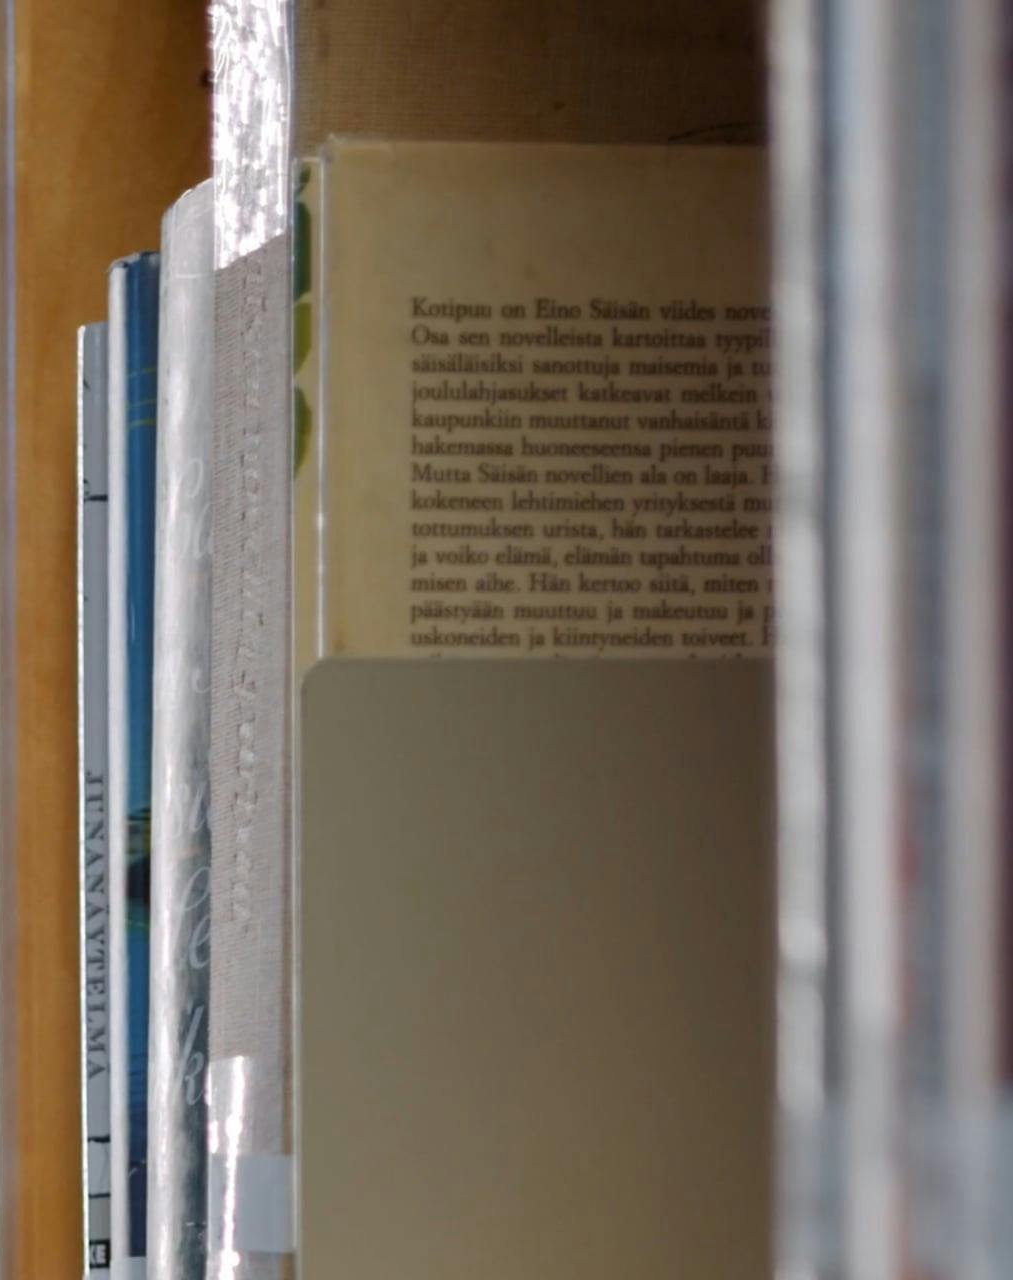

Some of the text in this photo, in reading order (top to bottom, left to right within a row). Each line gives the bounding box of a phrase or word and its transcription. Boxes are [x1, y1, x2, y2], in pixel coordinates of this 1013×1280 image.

[412, 297, 492, 324] Kotipuu
[501, 304, 526, 319] on
[535, 298, 582, 319] Eino
[590, 298, 651, 320] Säisän
[660, 299, 716, 320] viides
[411, 324, 450, 346] Osa
[459, 330, 491, 346] sen
[533, 353, 621, 380] sanottuja
[629, 354, 719, 375] maisemia
[726, 354, 746, 381] ja
[578, 381, 672, 403] katkeavat
[680, 382, 758, 403] melkein
[411, 407, 523, 434] kaupunkiin
[529, 411, 631, 430] muuttanut
[411, 434, 514, 456] hakemassa
[521, 435, 654, 457] huoneeseensa
[659, 436, 724, 463] pienen
[412, 462, 472, 484] Mutta
[479, 463, 539, 484] Säisän
[545, 463, 634, 485] novellien
[639, 464, 668, 485] ala
[673, 470, 698, 485] on
[704, 464, 755, 491] laaja.
[410, 489, 504, 511] kokeneen
[511, 490, 625, 512] lehtimiehen
[412, 516, 535, 538] tottumuksen
[543, 517, 605, 542] urista,
[612, 517, 647, 539] hän
[656, 518, 759, 539] tarkastelee
[411, 543, 428, 570] ja
[436, 543, 489, 565] voiko
[495, 544, 557, 569] elämä,
[564, 544, 633, 566] elämän
[639, 545, 744, 572] tapahtuma
[411, 570, 467, 592] misen
[475, 571, 520, 592] aihe.
[529, 571, 571, 592] Hän
[578, 571, 642, 593] kertoo
[649, 572, 695, 597] siitä,
[703, 572, 759, 594] miten
[513, 602, 598, 620] muuttuu
[606, 599, 624, 626] ja
[632, 600, 729, 621] makeutuu
[737, 600, 754, 627] ja
[411, 624, 521, 646] uskoneiden
[529, 625, 545, 652] ja
[85, 770, 110, 1080] JUNANÄYTELMÄ
